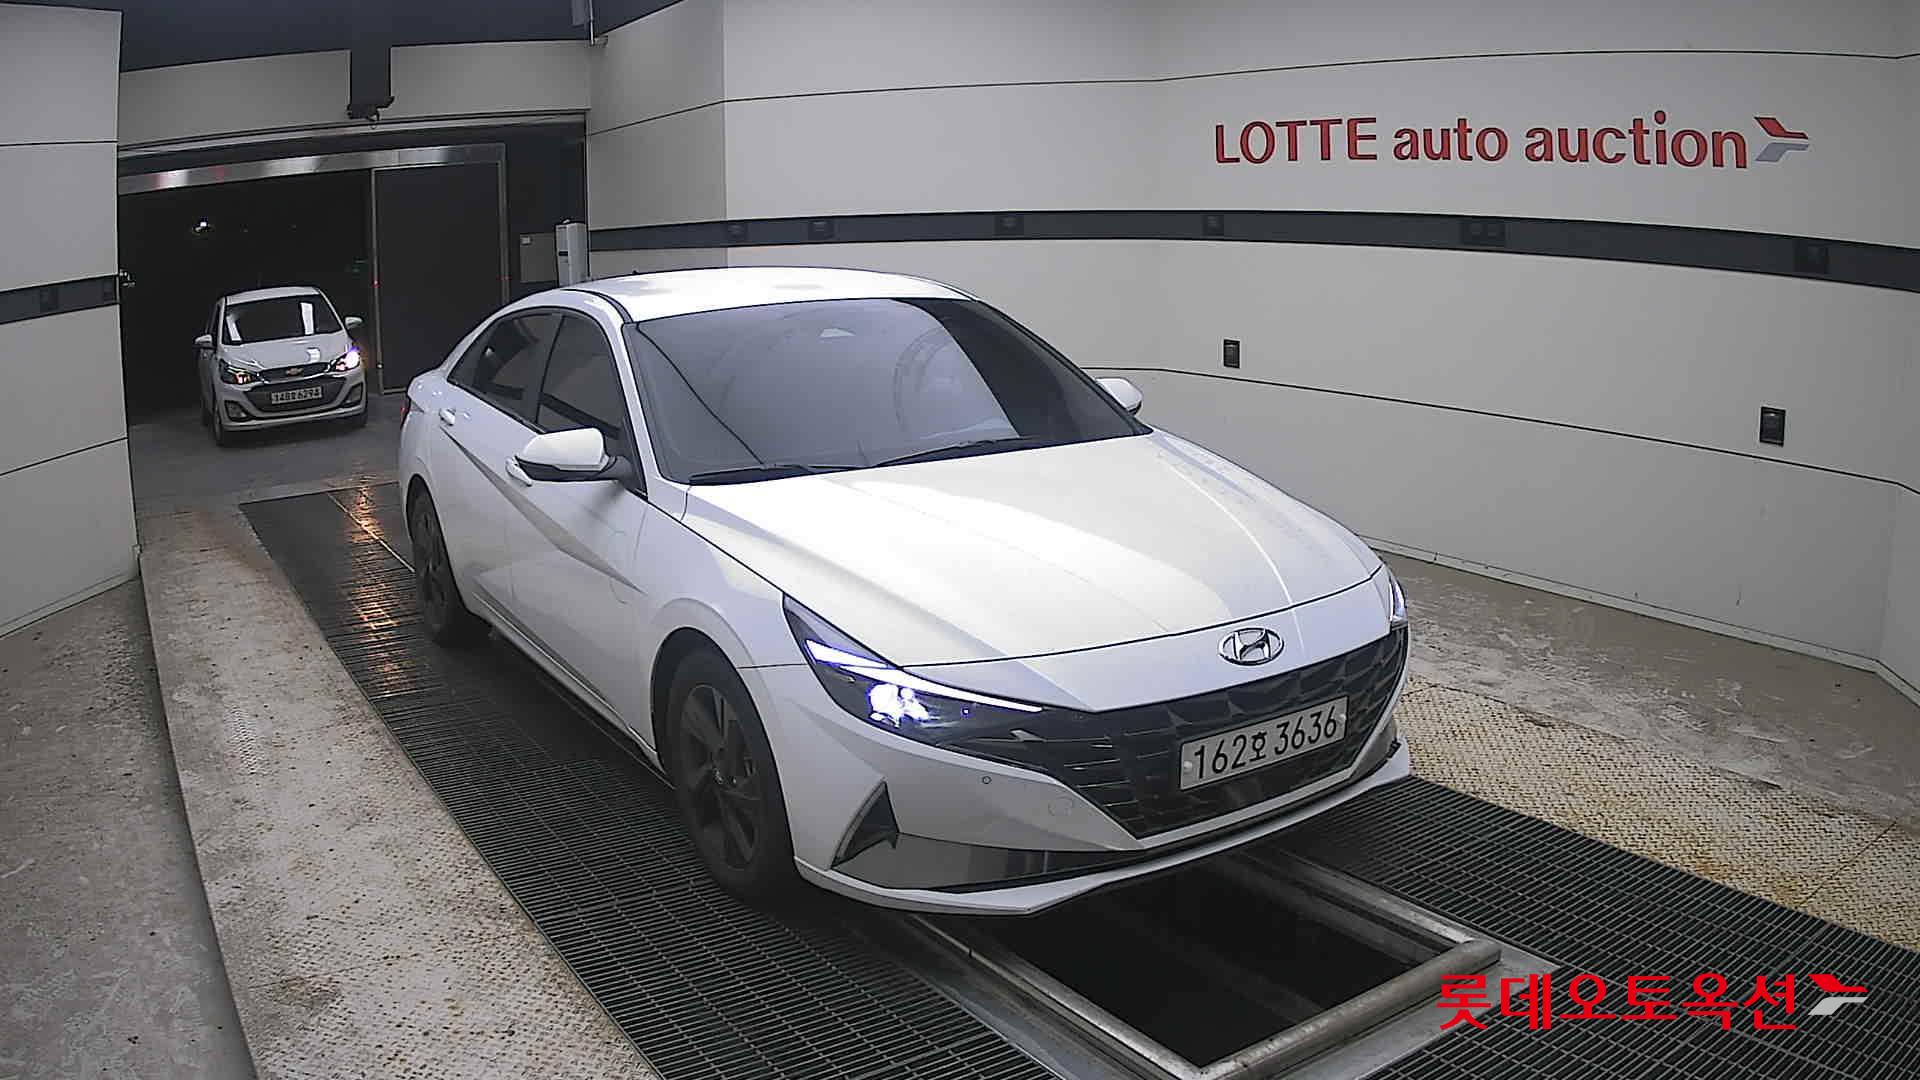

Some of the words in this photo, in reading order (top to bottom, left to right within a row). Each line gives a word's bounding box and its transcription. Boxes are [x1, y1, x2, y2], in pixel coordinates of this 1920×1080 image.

[1215, 117, 1378, 164] LOTTE
[1392, 118, 1509, 162] auto
[1524, 110, 1748, 169] auction
